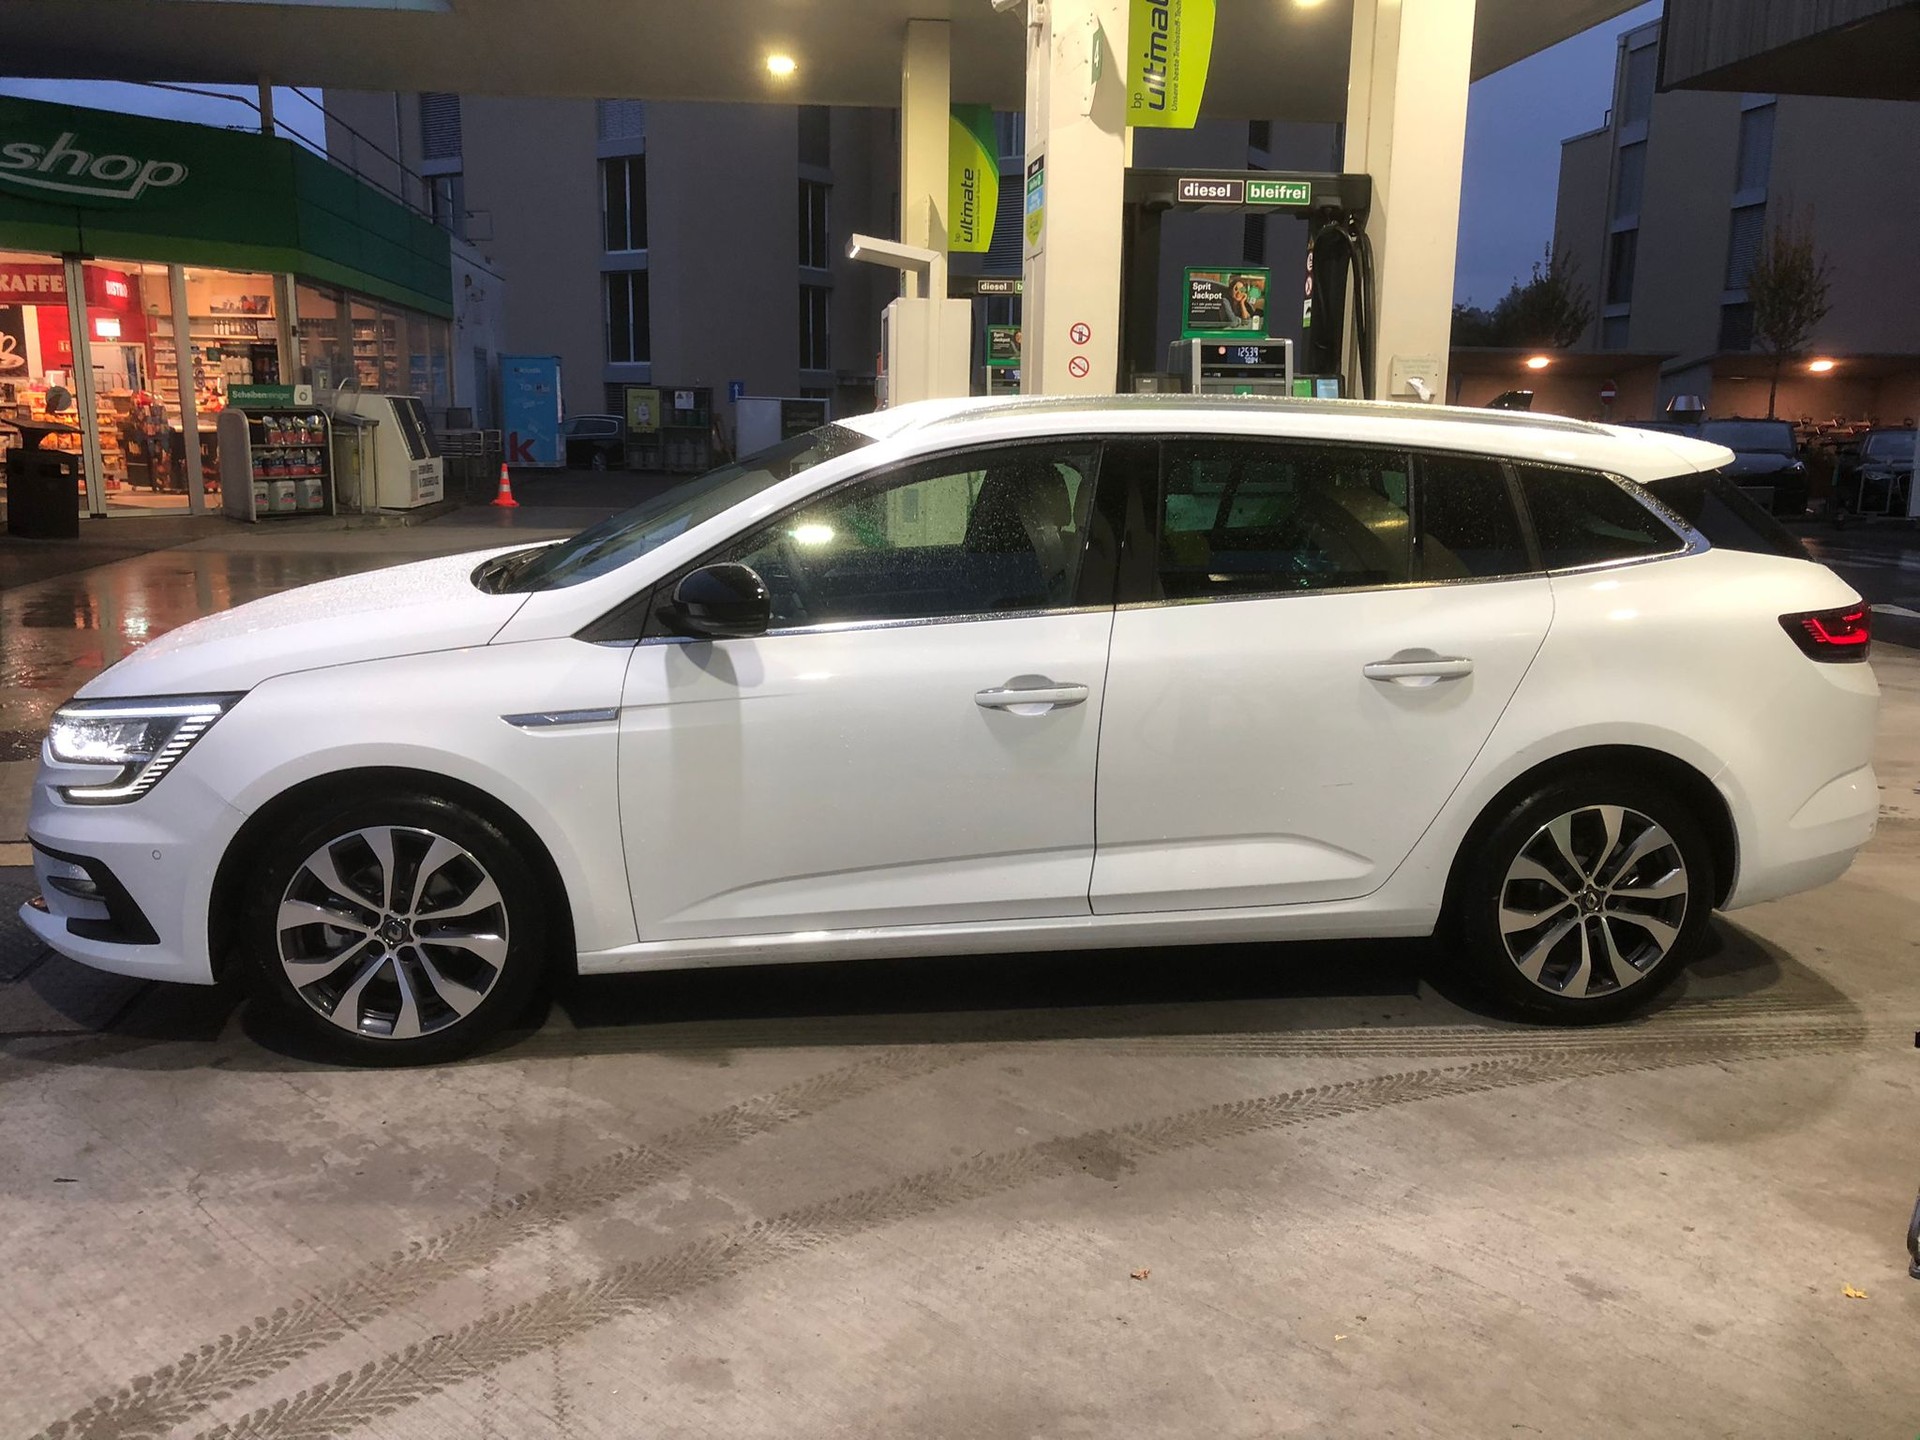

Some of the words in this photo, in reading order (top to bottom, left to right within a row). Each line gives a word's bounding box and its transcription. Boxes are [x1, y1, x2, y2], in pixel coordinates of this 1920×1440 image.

[1094, 40, 1100, 67] 4
[1131, 92, 1144, 109] bp
[1171, 83, 1179, 111] Unsere
[0, 132, 187, 198] shop
[1184, 183, 1231, 197] diesel
[1250, 185, 1307, 199] bleifrei
[960, 168, 974, 243] ultimate
[0, 274, 66, 292] KAFFE
[981, 282, 1007, 291] diesel
[1192, 282, 1211, 291] Sprit
[1192, 291, 1222, 301] Jackpot
